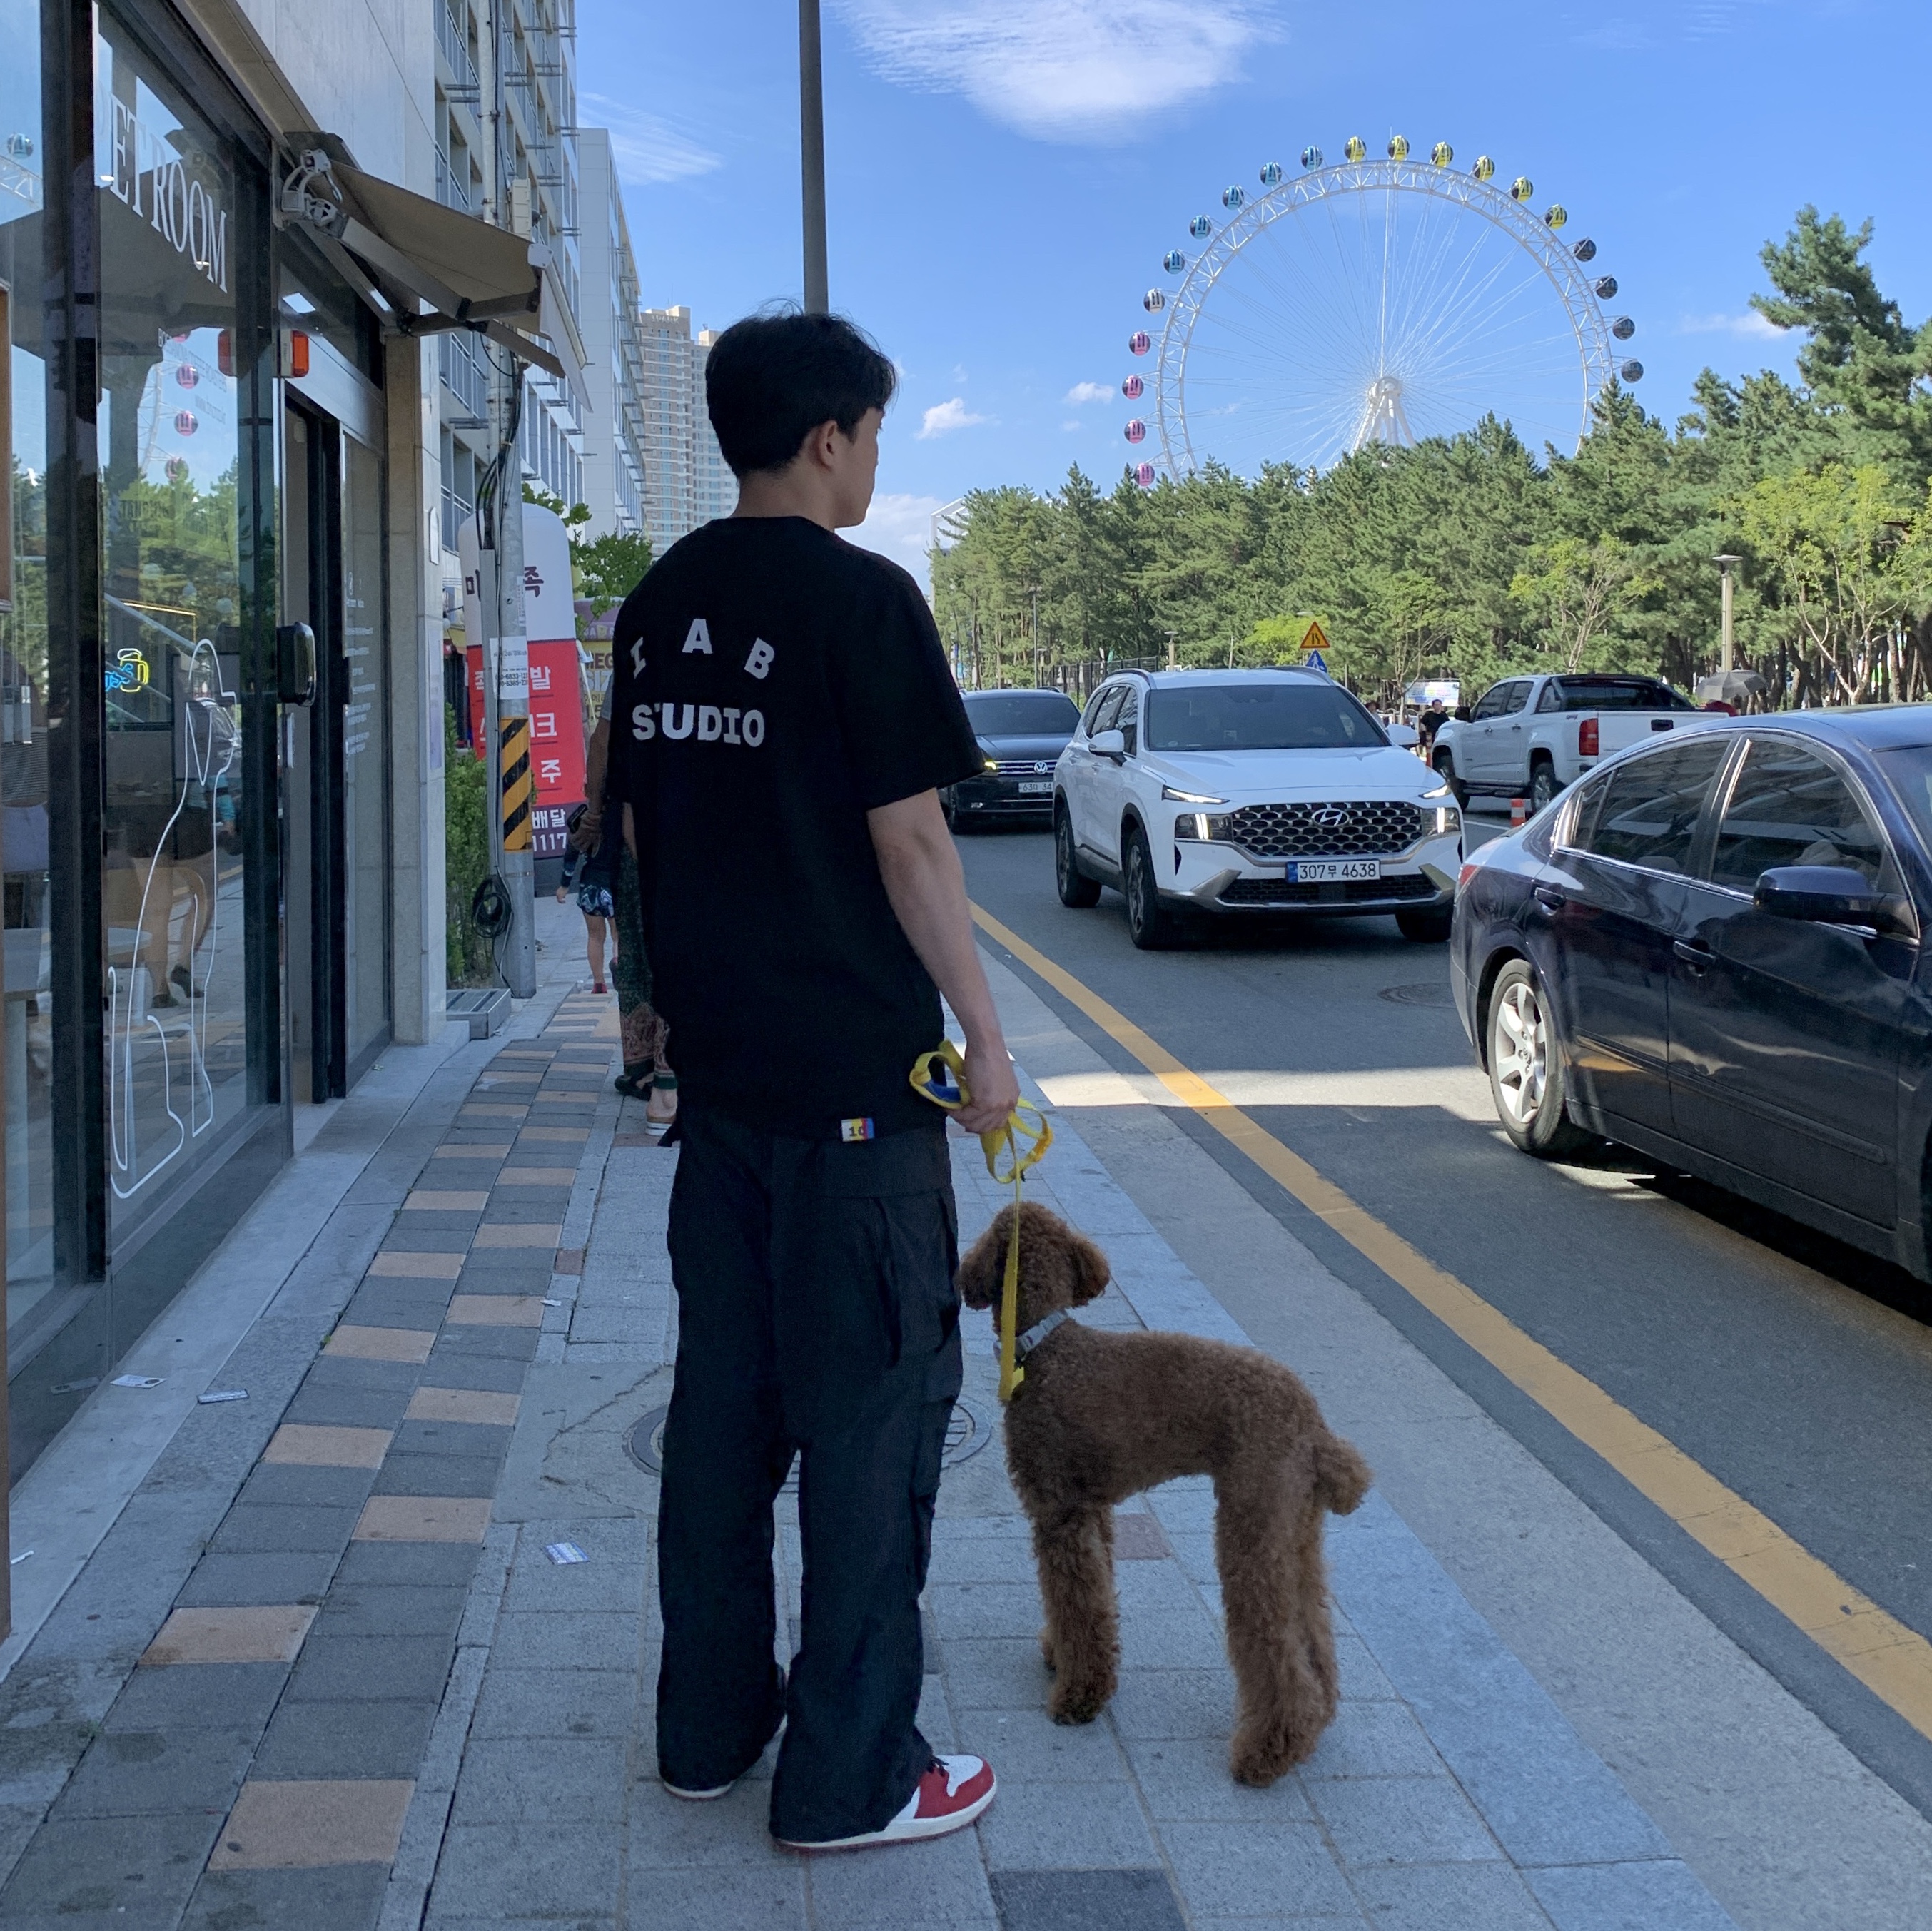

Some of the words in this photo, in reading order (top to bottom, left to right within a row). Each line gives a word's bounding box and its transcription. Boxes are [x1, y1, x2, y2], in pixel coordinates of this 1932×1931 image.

[150, 133, 228, 294] ROOM
[632, 702, 765, 747] SUDIO
[532, 809, 566, 829] 배달
[1300, 864, 1337, 880] 307무
[1341, 863, 1376, 878] 4638
